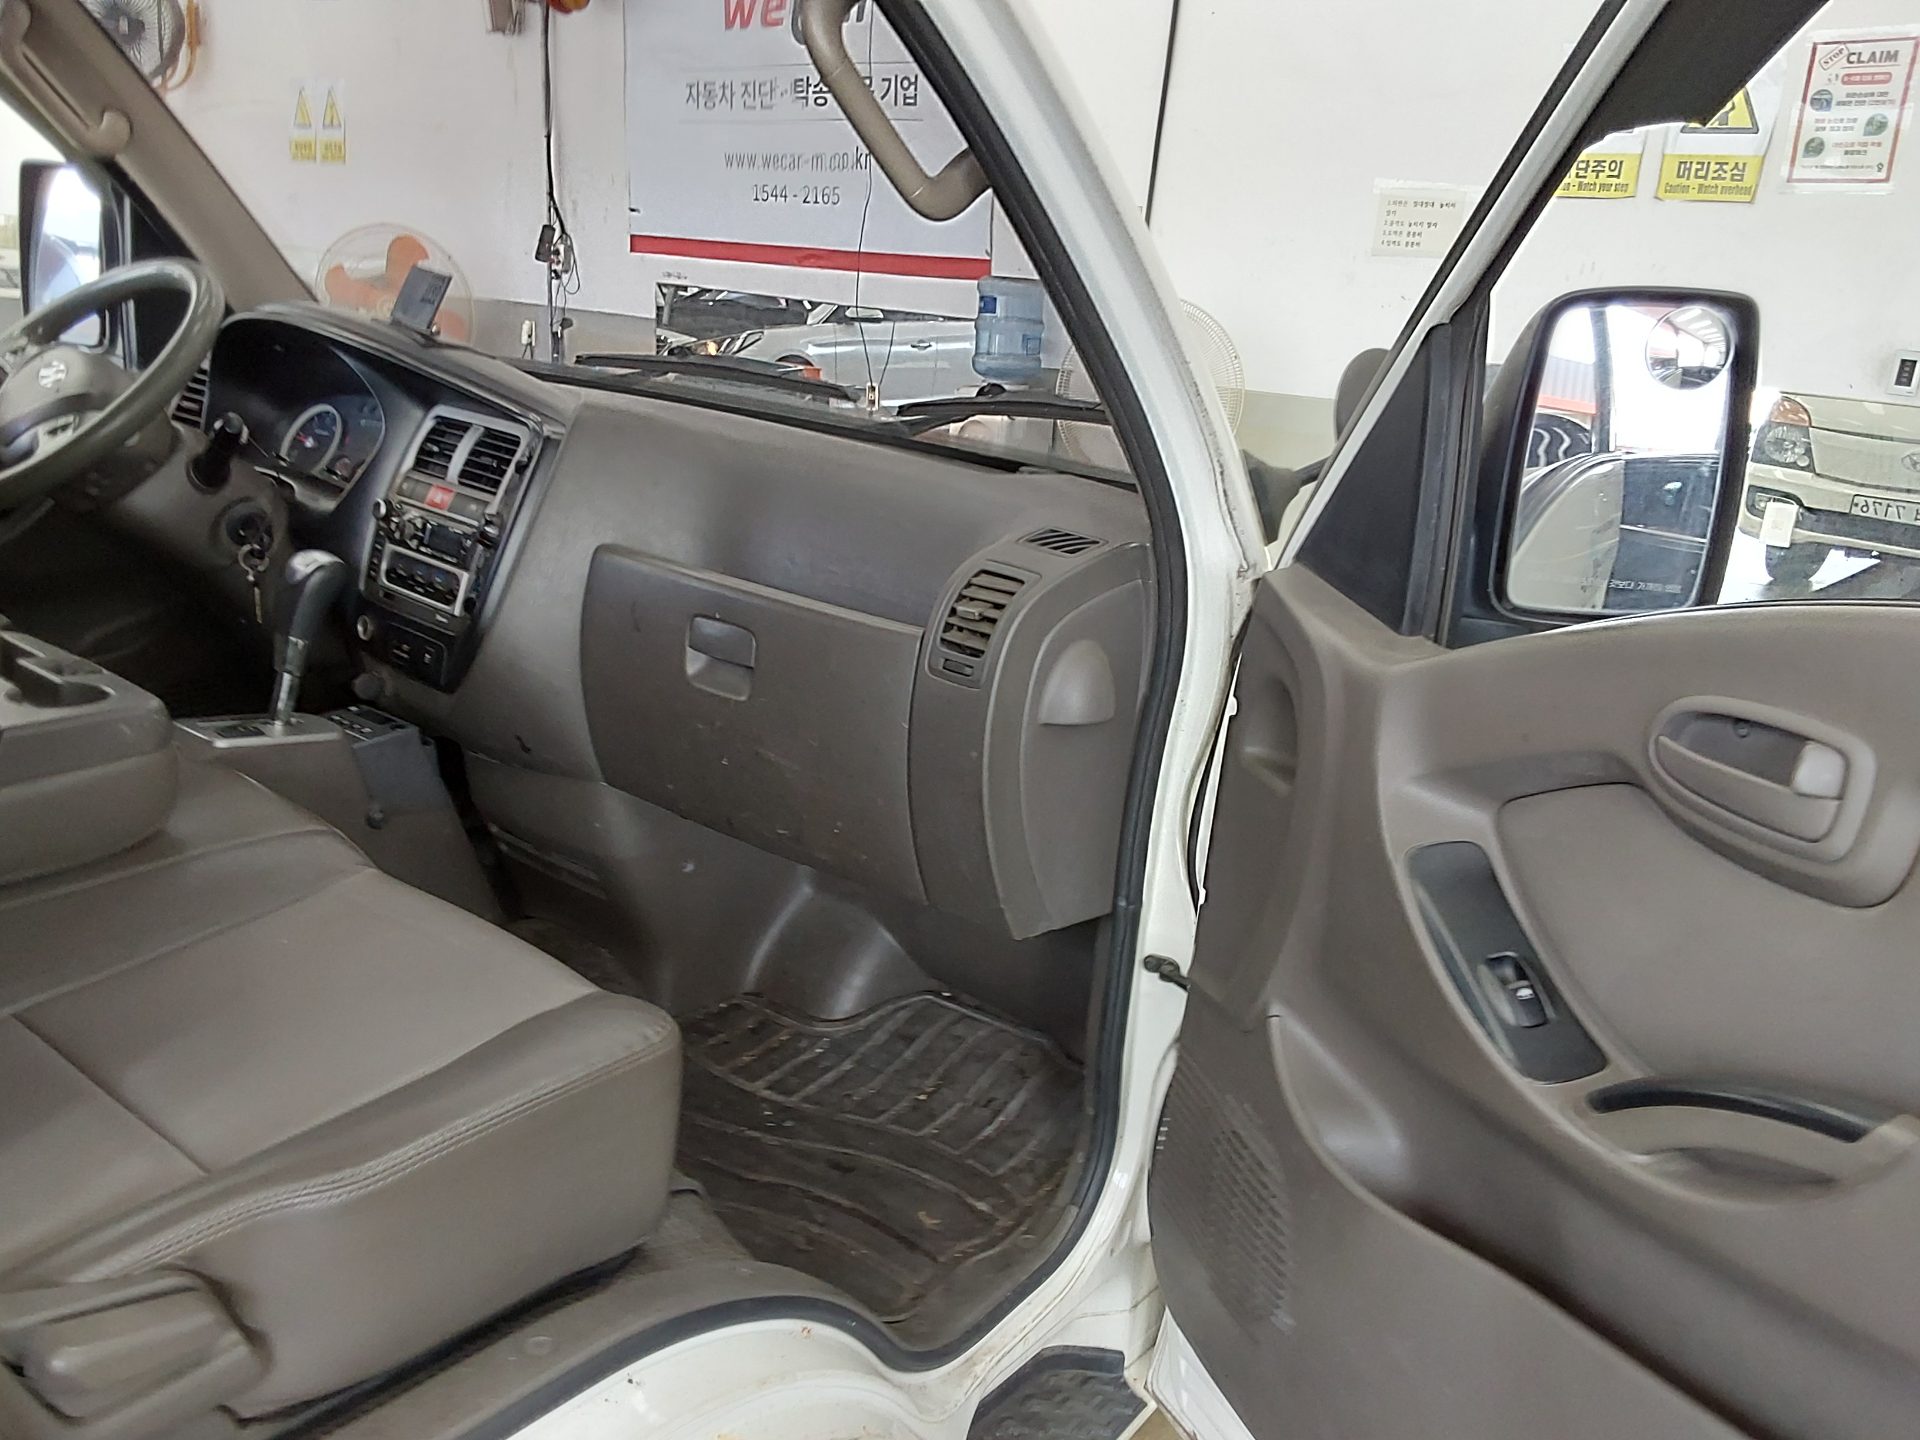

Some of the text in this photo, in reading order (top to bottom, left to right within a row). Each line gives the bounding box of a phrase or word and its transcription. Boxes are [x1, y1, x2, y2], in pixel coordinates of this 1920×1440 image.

[1822, 47, 1900, 66] STOP CLAIM
[685, 80, 735, 111] 자동차
[880, 74, 918, 107] 기업
[1567, 159, 1624, 179] 단주의
[1676, 160, 1748, 182] 머리조심
[1664, 182, 1690, 194] Caution
